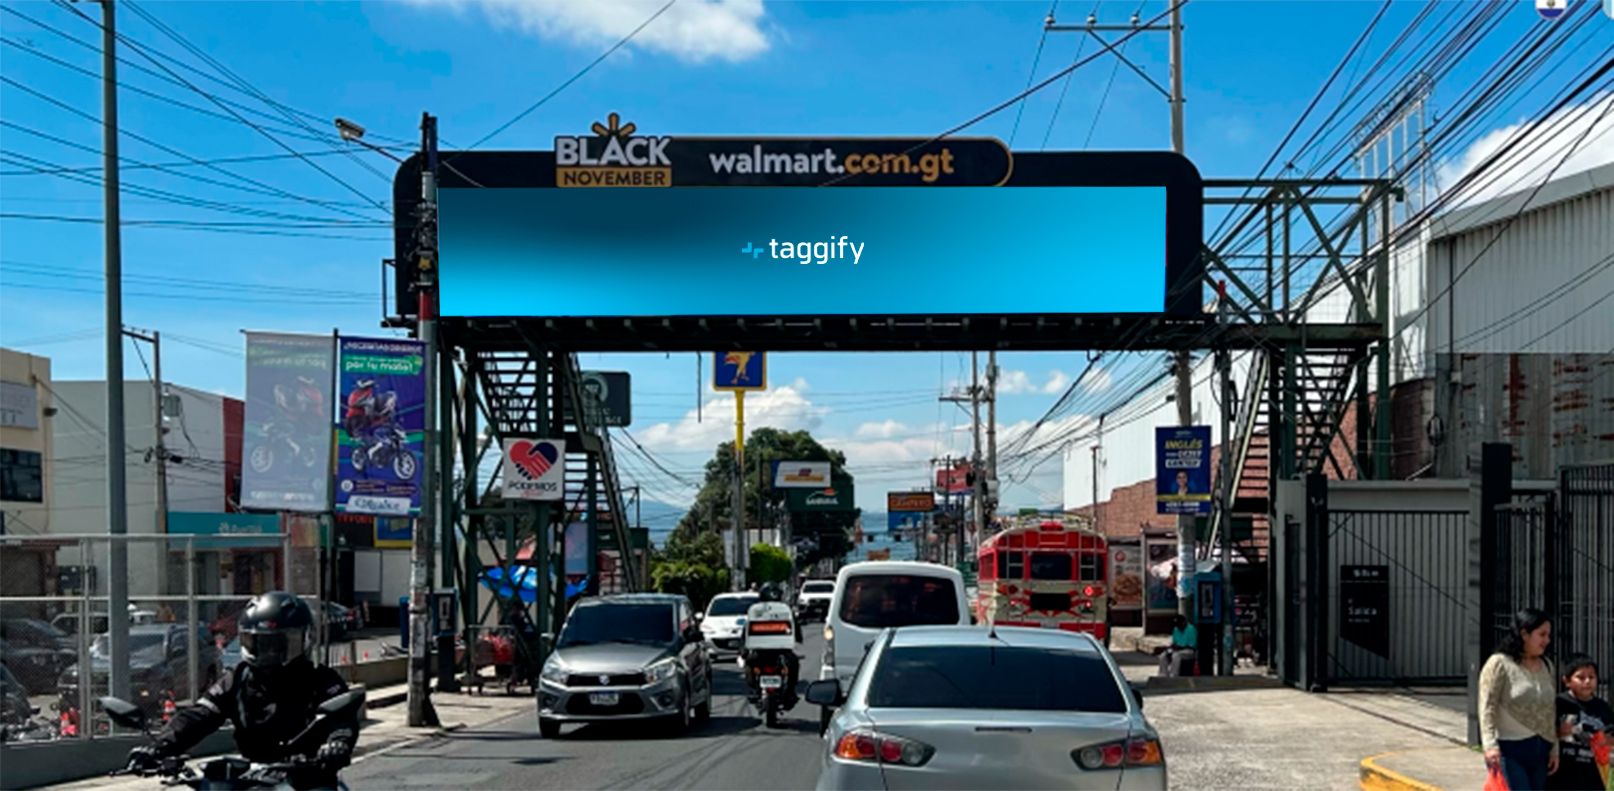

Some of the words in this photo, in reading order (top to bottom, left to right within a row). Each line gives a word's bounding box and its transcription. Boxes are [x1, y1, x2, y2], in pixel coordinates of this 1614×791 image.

[556, 135, 672, 166] BLACK
[709, 144, 954, 182] walmart.com.gt
[563, 170, 666, 186] NOVEMBER
[769, 235, 865, 264] taggify
[508, 481, 557, 492] PODEMOS
